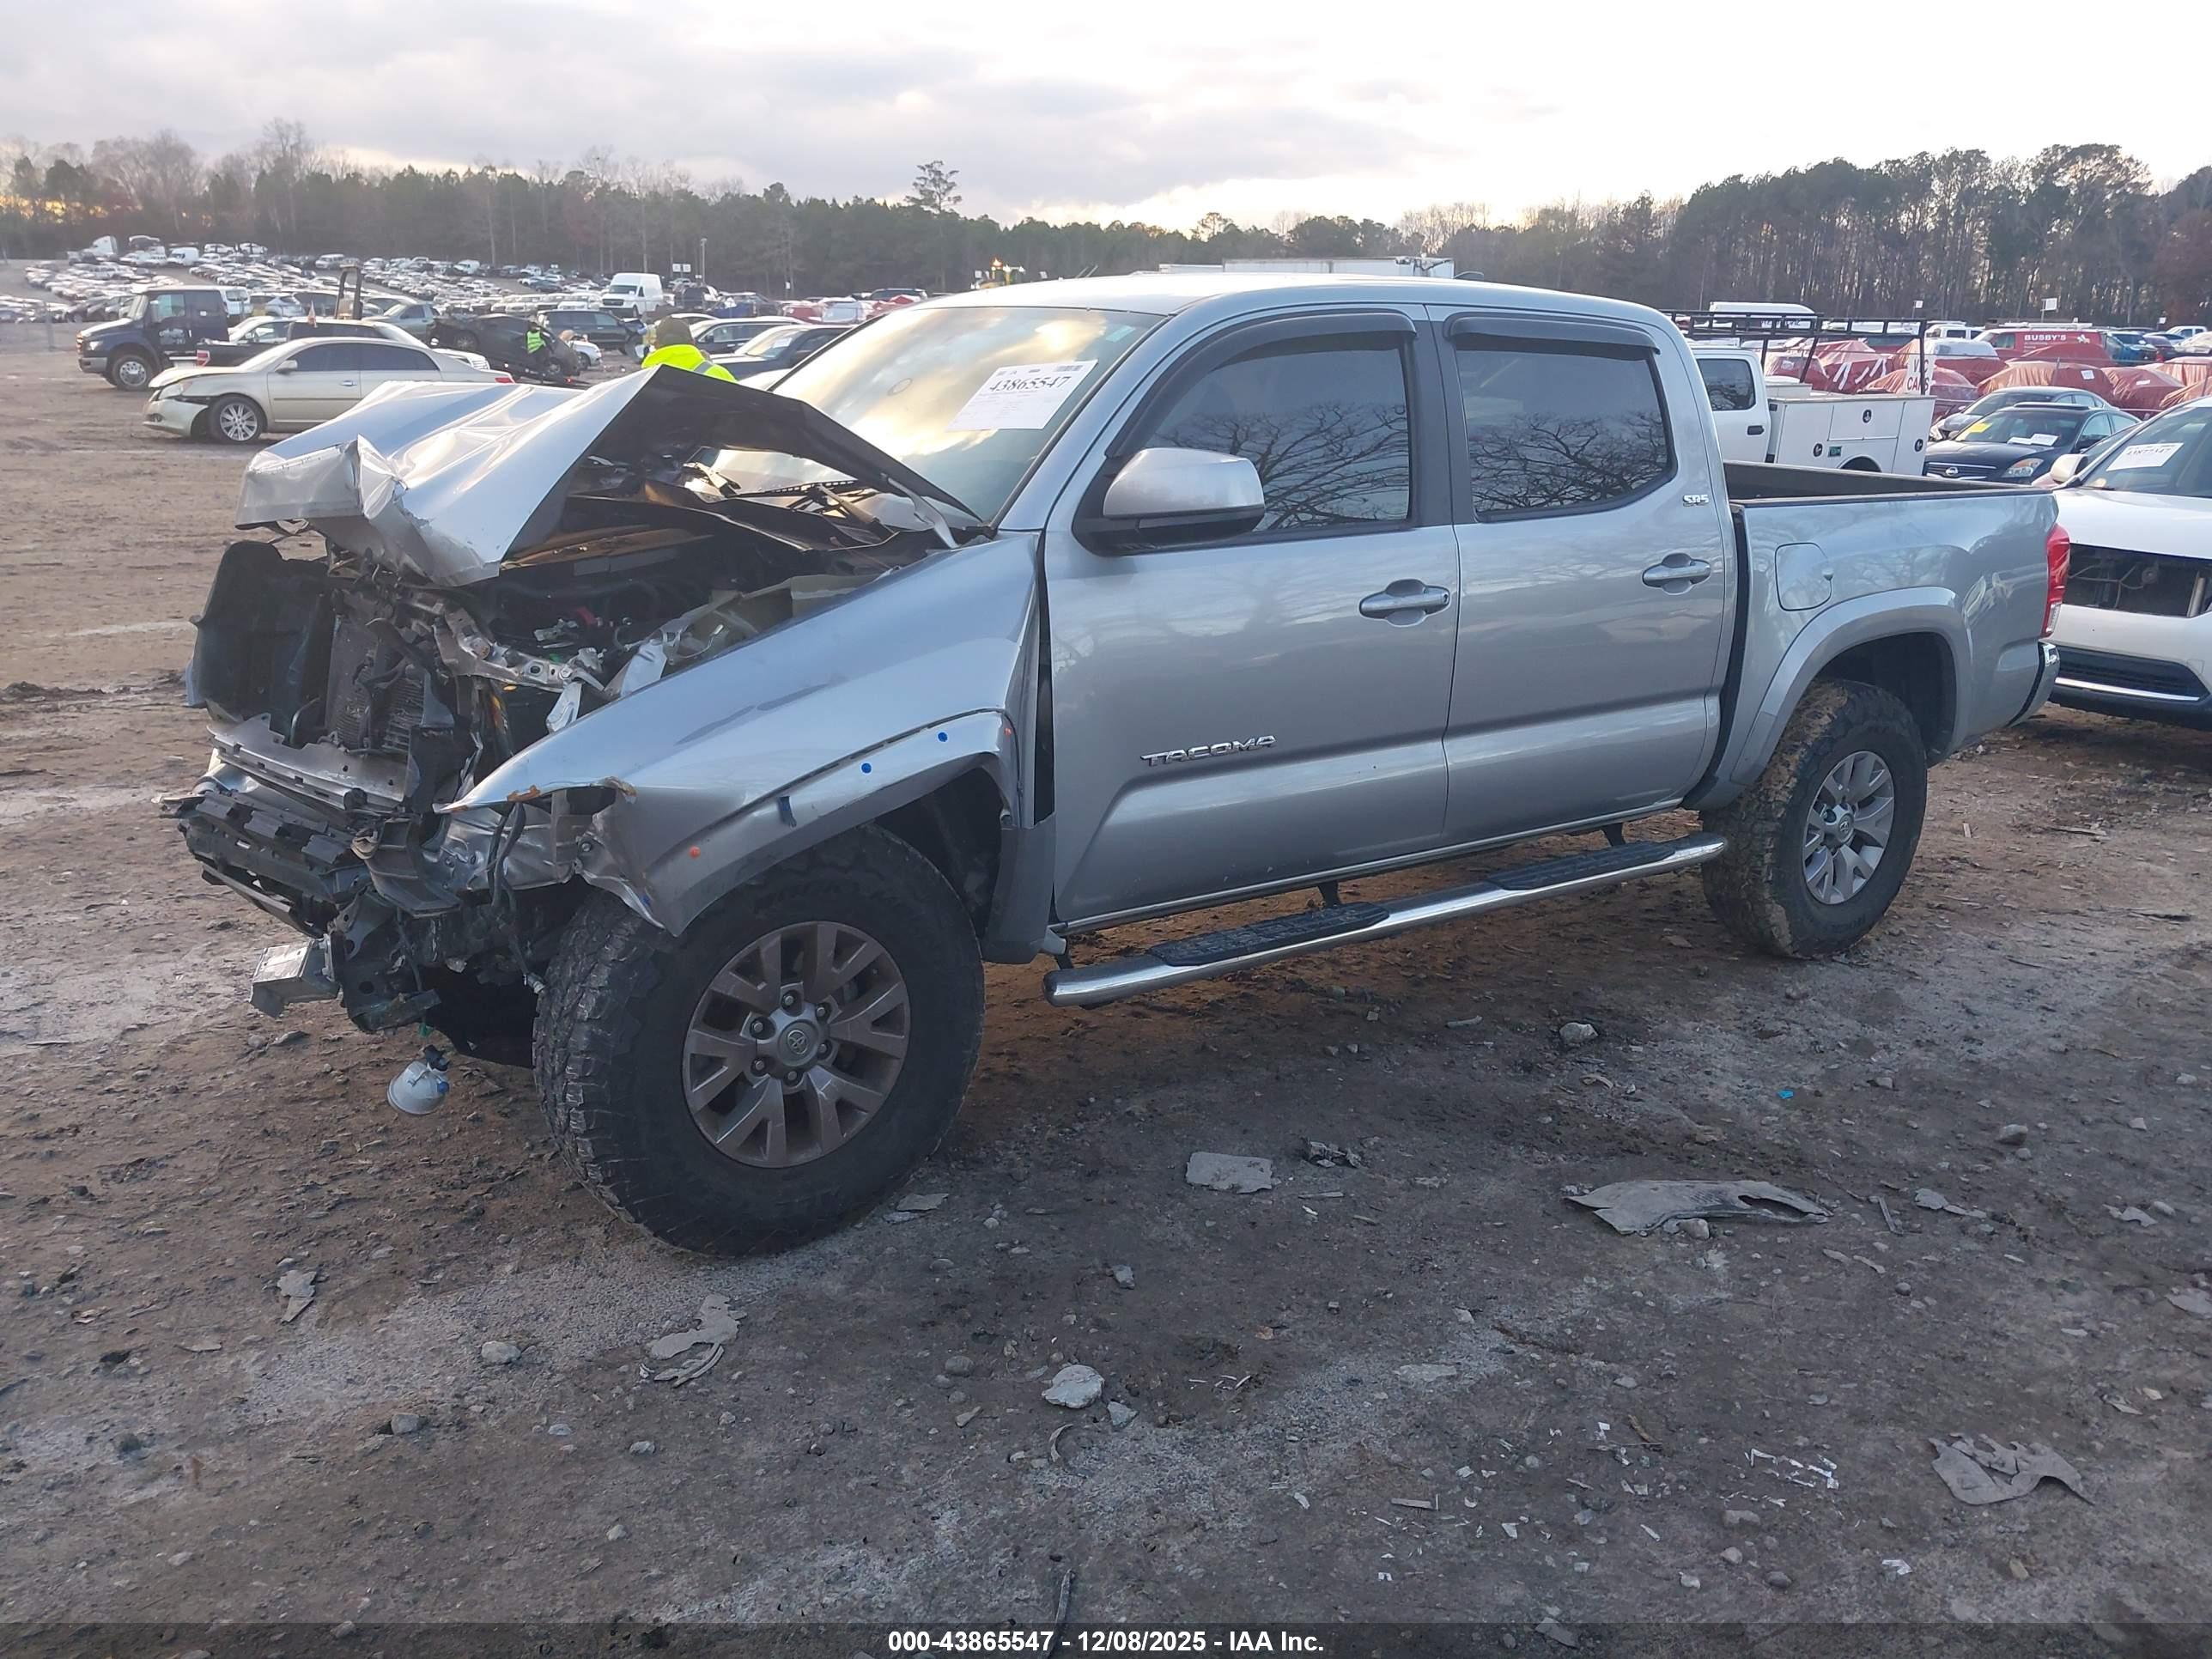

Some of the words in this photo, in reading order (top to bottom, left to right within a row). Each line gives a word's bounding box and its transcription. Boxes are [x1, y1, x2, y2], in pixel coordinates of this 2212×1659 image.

[1914, 358, 1929, 373] VC
[989, 376, 1073, 392] 43865547
[1907, 376, 1929, 392] CAS
[1683, 494, 1710, 507] SR5
[1140, 734, 1278, 767] TACOMA
